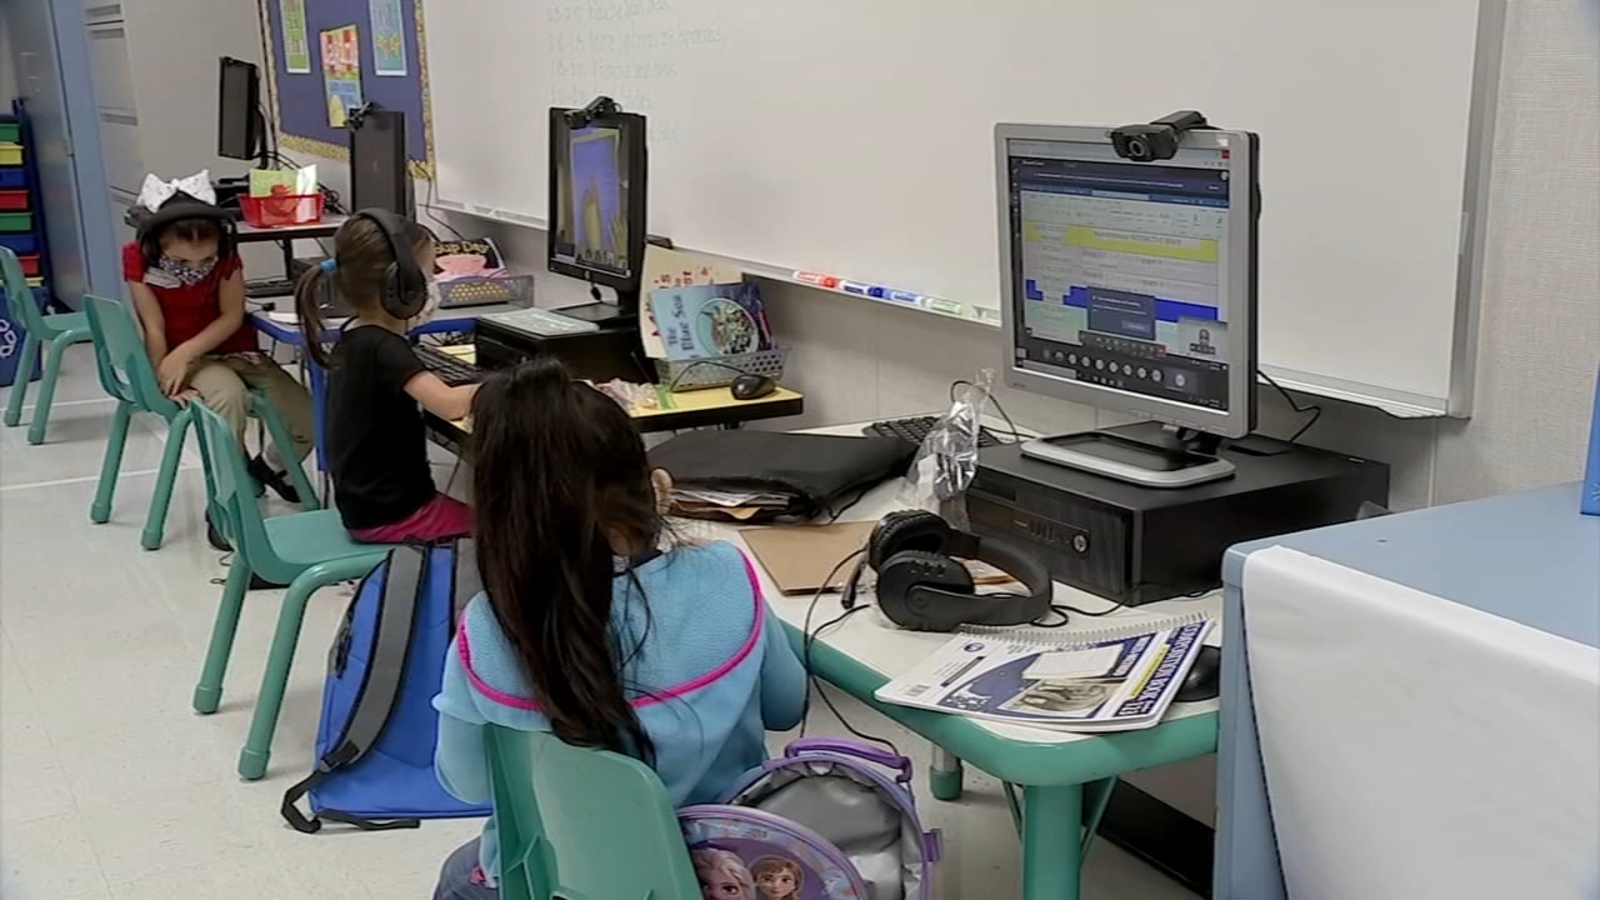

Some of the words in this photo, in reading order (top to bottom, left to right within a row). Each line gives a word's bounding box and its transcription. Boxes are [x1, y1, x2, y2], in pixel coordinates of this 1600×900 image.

[671, 294, 686, 319] Sea
[667, 326, 678, 348] The
[680, 321, 695, 351] Blue
